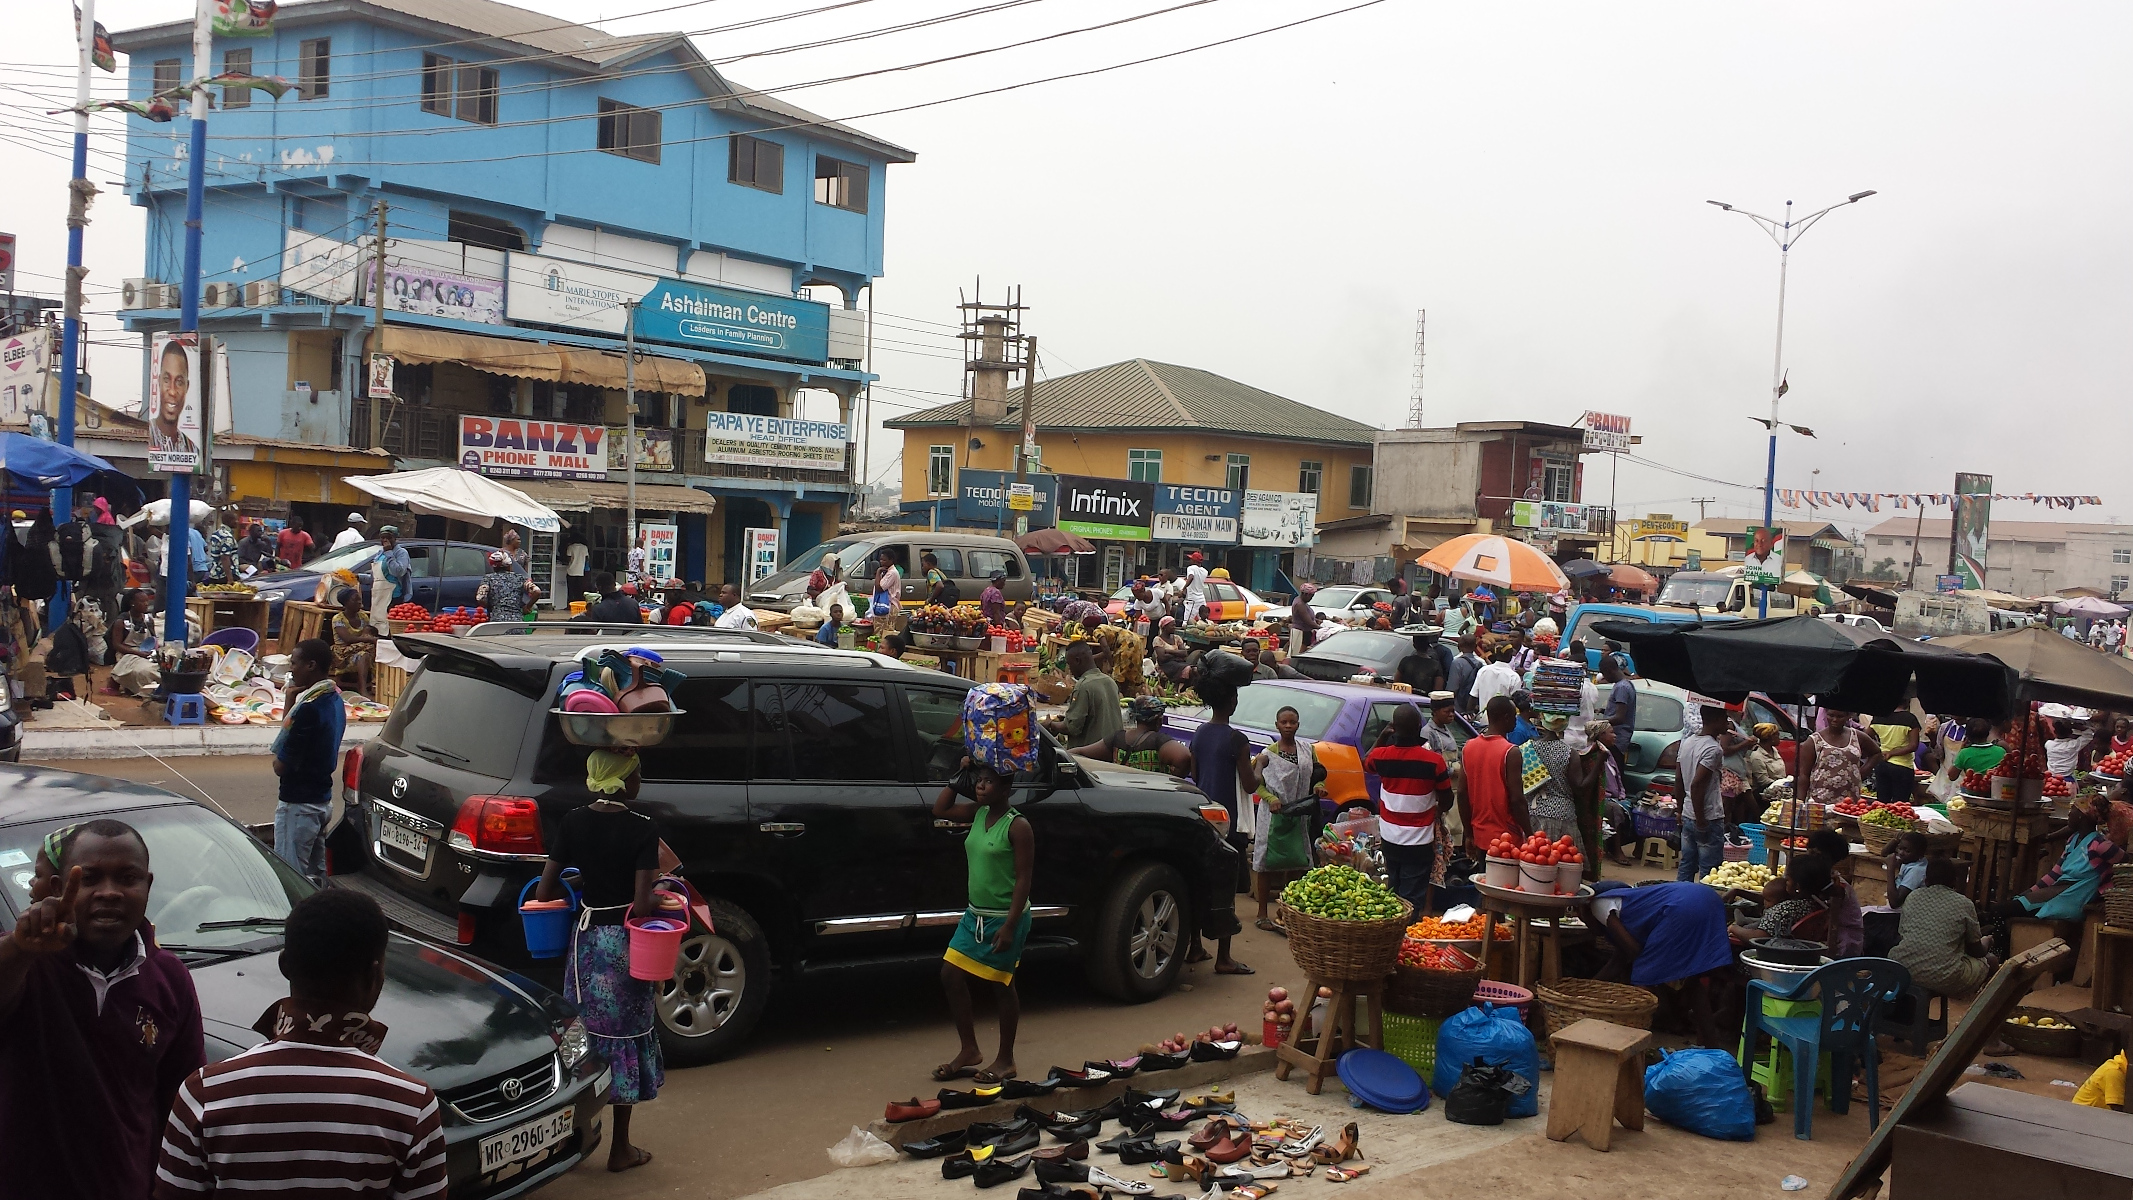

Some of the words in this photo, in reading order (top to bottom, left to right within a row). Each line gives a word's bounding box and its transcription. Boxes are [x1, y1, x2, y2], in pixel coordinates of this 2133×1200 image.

[566, 286, 590, 297] MARIE
[593, 289, 620, 301] STOPES
[566, 296, 620, 310] INTERNATIONAL
[661, 292, 743, 322] Ashaiman
[747, 304, 798, 330] Centre
[690, 324, 716, 335] Leaders
[725, 329, 746, 341] Family
[747, 332, 774, 345] Planning
[3, 347, 26, 363] ELBEE
[708, 413, 743, 431] PAPA
[746, 416, 764, 432] YE
[768, 418, 846, 439] ENTERPRISE
[1594, 412, 1631, 434] BANZY
[463, 417, 606, 455] BANZY
[750, 434, 775, 442] HEAD
[778, 435, 807, 444] OFFICE
[711, 438, 737, 446] DEALERS
[747, 441, 769, 449] QUALITY
[149, 453, 167, 461] ERNEST
[168, 453, 197, 464] NORGBEY
[484, 451, 538, 466] PHONE
[548, 455, 590, 469] MALL
[778, 450, 801, 458] ROOFING
[965, 487, 1001, 500] TECNO
[1167, 487, 1232, 504] TECNO
[978, 499, 1000, 508] Mobile
[1070, 488, 1141, 517] Infinix
[1175, 504, 1222, 516] AGENT
[1070, 525, 1092, 533] ORIGINAL
[1093, 527, 1113, 535] PHONES
[1177, 518, 1213, 531] ASHAIMAN
[1215, 519, 1231, 532] MAIN
[1642, 520, 1680, 530] PENTECOST
[651, 529, 674, 539] BANZY
[757, 533, 776, 541] BANZY
[458, 862, 471, 874] V6
[485, 1140, 503, 1166] WR
[511, 1114, 563, 1156] 2960-13
